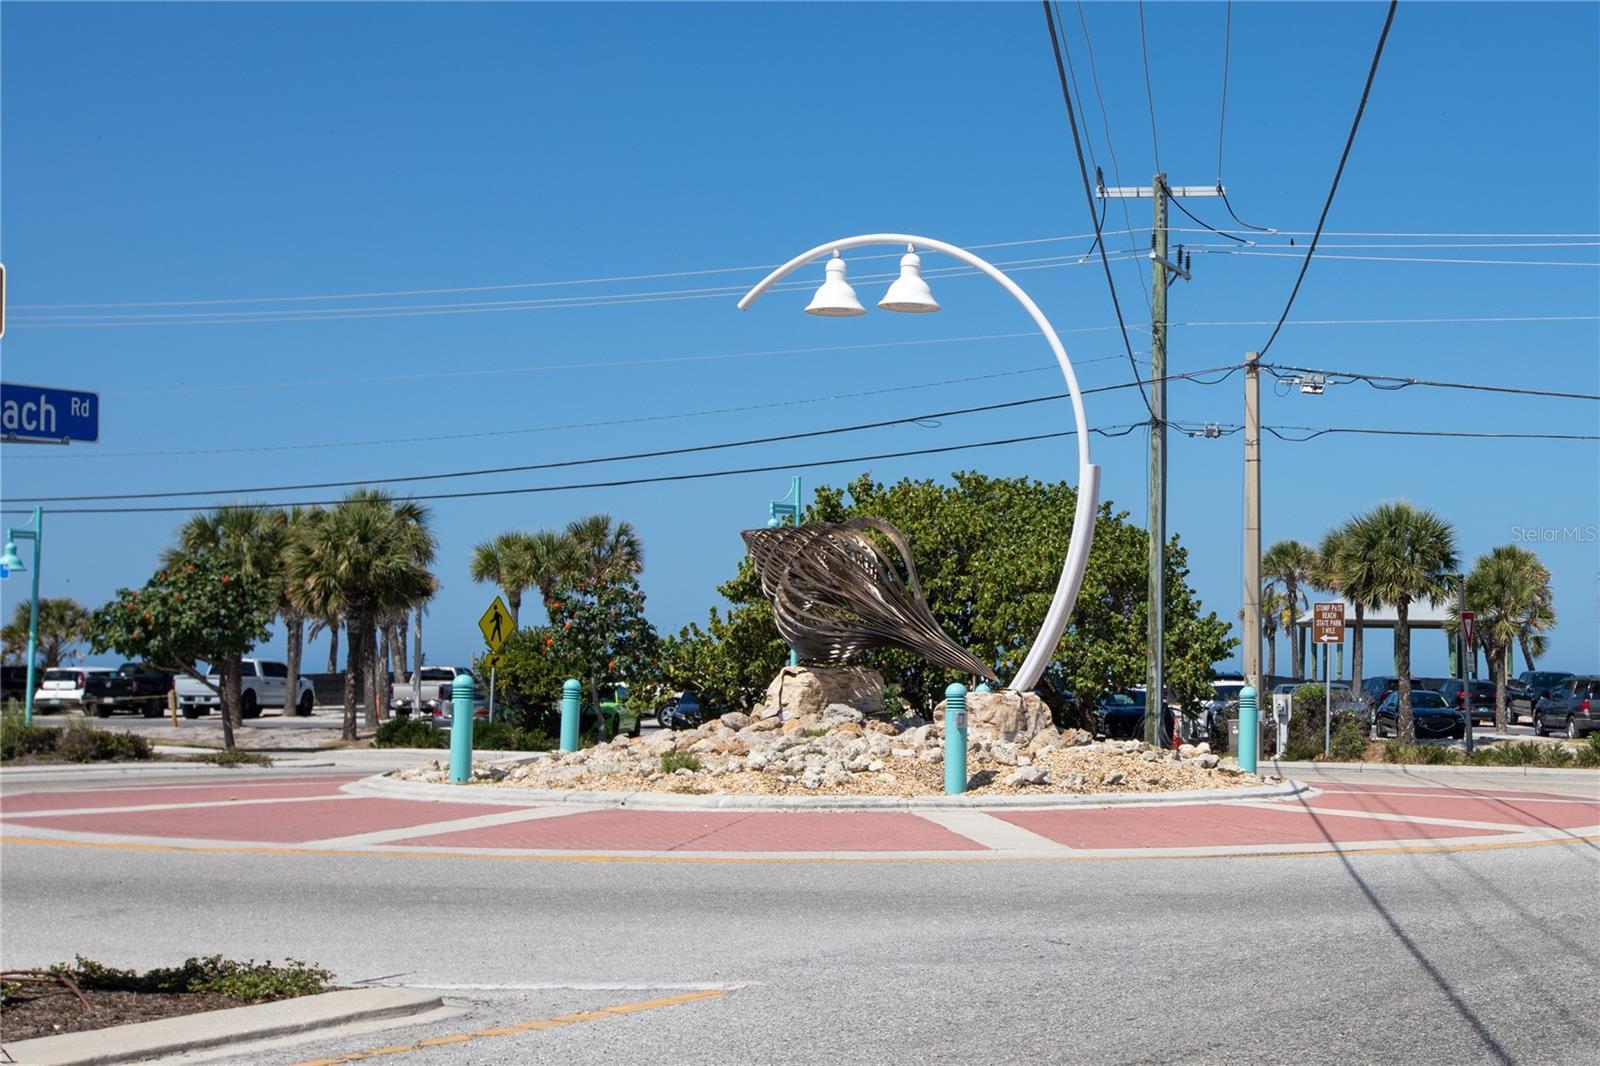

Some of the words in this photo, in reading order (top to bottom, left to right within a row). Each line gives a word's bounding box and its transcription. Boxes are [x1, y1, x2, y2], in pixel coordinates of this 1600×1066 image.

[2, 394, 56, 432] ach
[71, 397, 90, 417] Rd
[1316, 619, 1329, 627] STATE
[1330, 619, 1342, 627] PARK
